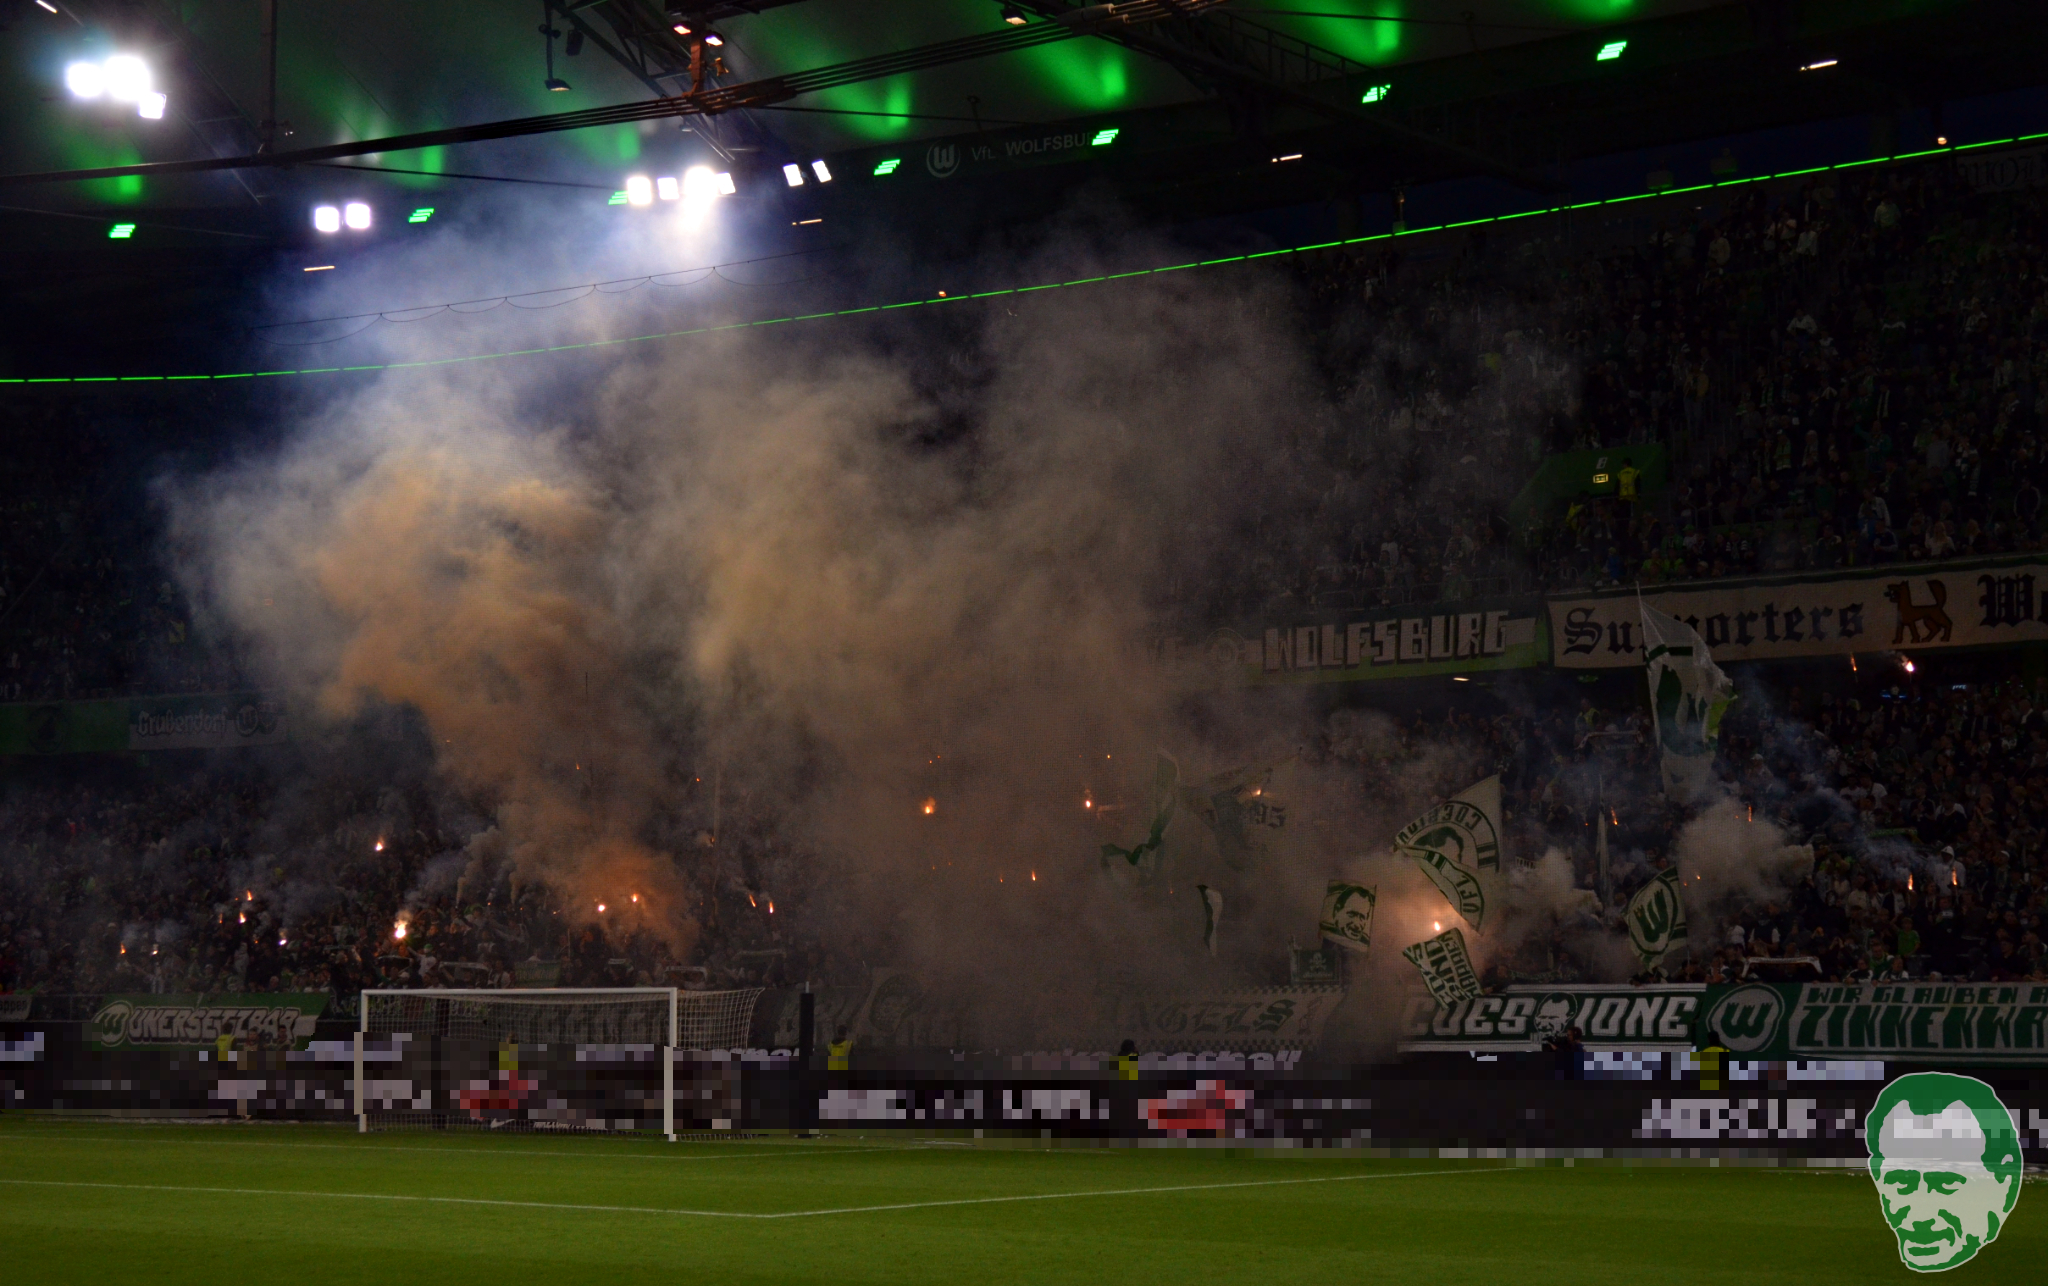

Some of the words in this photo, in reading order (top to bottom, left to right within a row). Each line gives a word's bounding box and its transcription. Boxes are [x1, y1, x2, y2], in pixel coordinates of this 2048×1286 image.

[971, 146, 997, 161] VfL
[1005, 132, 1094, 157] WOLFSBUR
[1263, 610, 1510, 675] WOLFSBURG
[1563, 602, 1866, 656] Suorters
[1806, 987, 1861, 1004] WIR
[1870, 986, 2019, 1004] GLAUBEN
